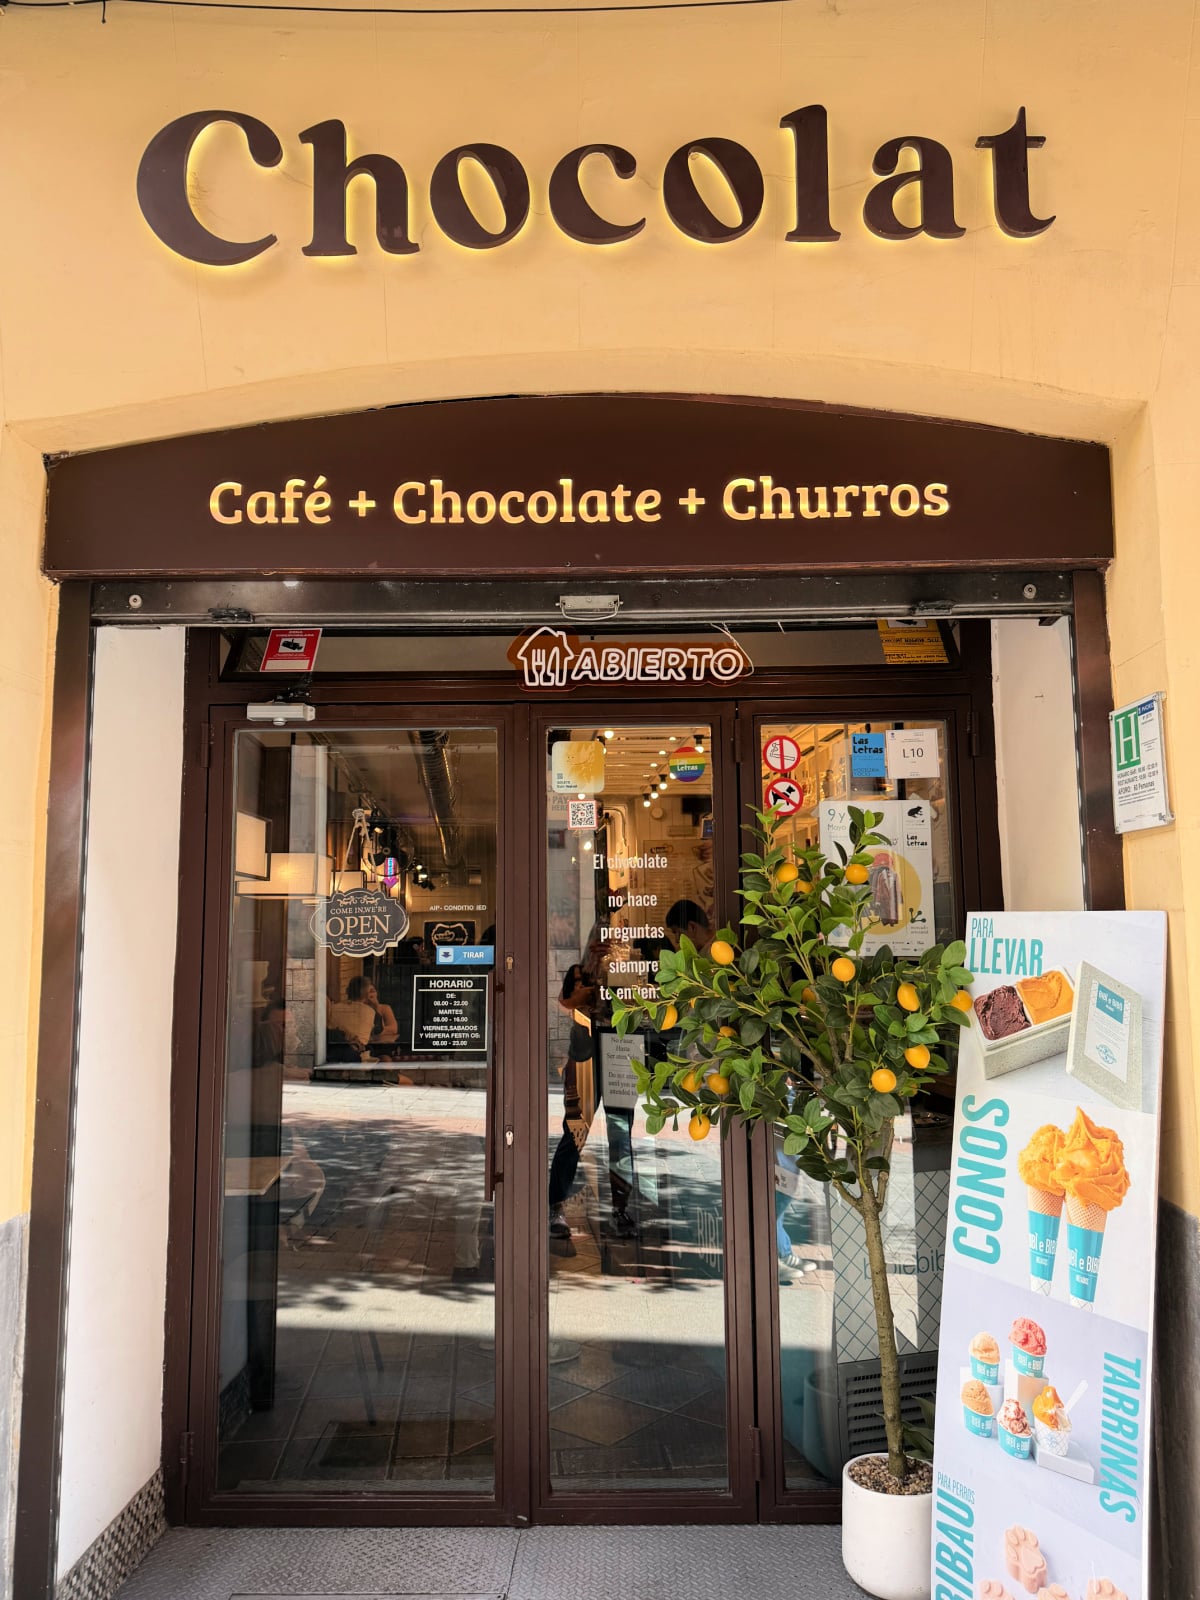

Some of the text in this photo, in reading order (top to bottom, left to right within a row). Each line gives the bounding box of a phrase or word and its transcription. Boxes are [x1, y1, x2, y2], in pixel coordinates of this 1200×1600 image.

[137, 104, 1057, 266] Chocolat
[208, 473, 951, 527] Café + Chocolate + Churros
[571, 647, 744, 681] ABIERTO
[852, 736, 869, 744] Las
[852, 746, 884, 754] Letras
[902, 748, 924, 758] L10
[828, 808, 836, 822] 9
[593, 854, 668, 870] El chocolate
[608, 892, 658, 908] no hace
[326, 914, 392, 937] OPEN
[600, 924, 665, 942] preguntas
[971, 918, 994, 938] PARA
[970, 938, 1044, 976] LLEVAR
[608, 960, 659, 974] siempre
[429, 980, 473, 989] HORARIO
[952, 1095, 1010, 1264] CONOS
[1039, 1240, 1044, 1252] e
[1079, 1257, 1084, 1269] e
[1098, 1351, 1142, 1524] TARRINAS
[937, 1472, 976, 1504] PARA PERROS
